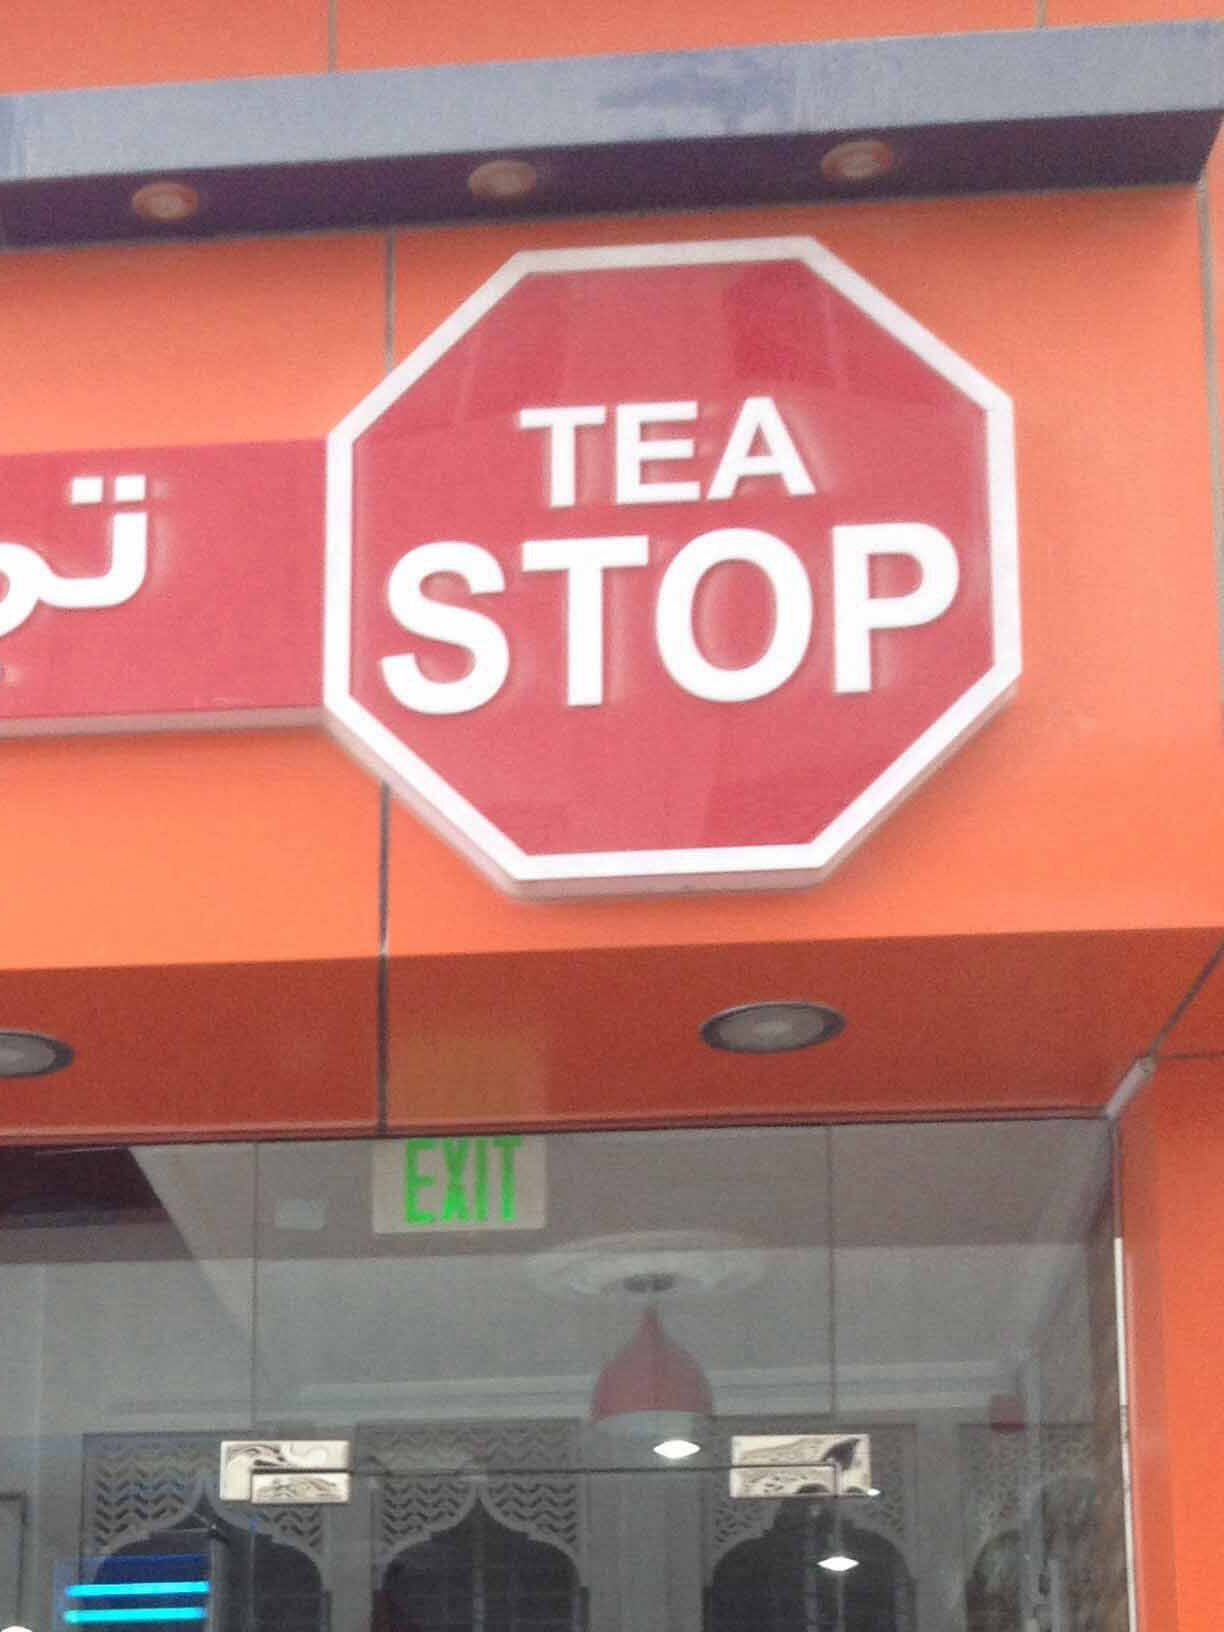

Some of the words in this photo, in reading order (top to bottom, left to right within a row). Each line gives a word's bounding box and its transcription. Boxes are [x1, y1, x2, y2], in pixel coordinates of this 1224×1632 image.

[516, 395, 817, 509] TEA
[379, 521, 961, 717] STOP
[403, 1135, 523, 1225] EXIT
